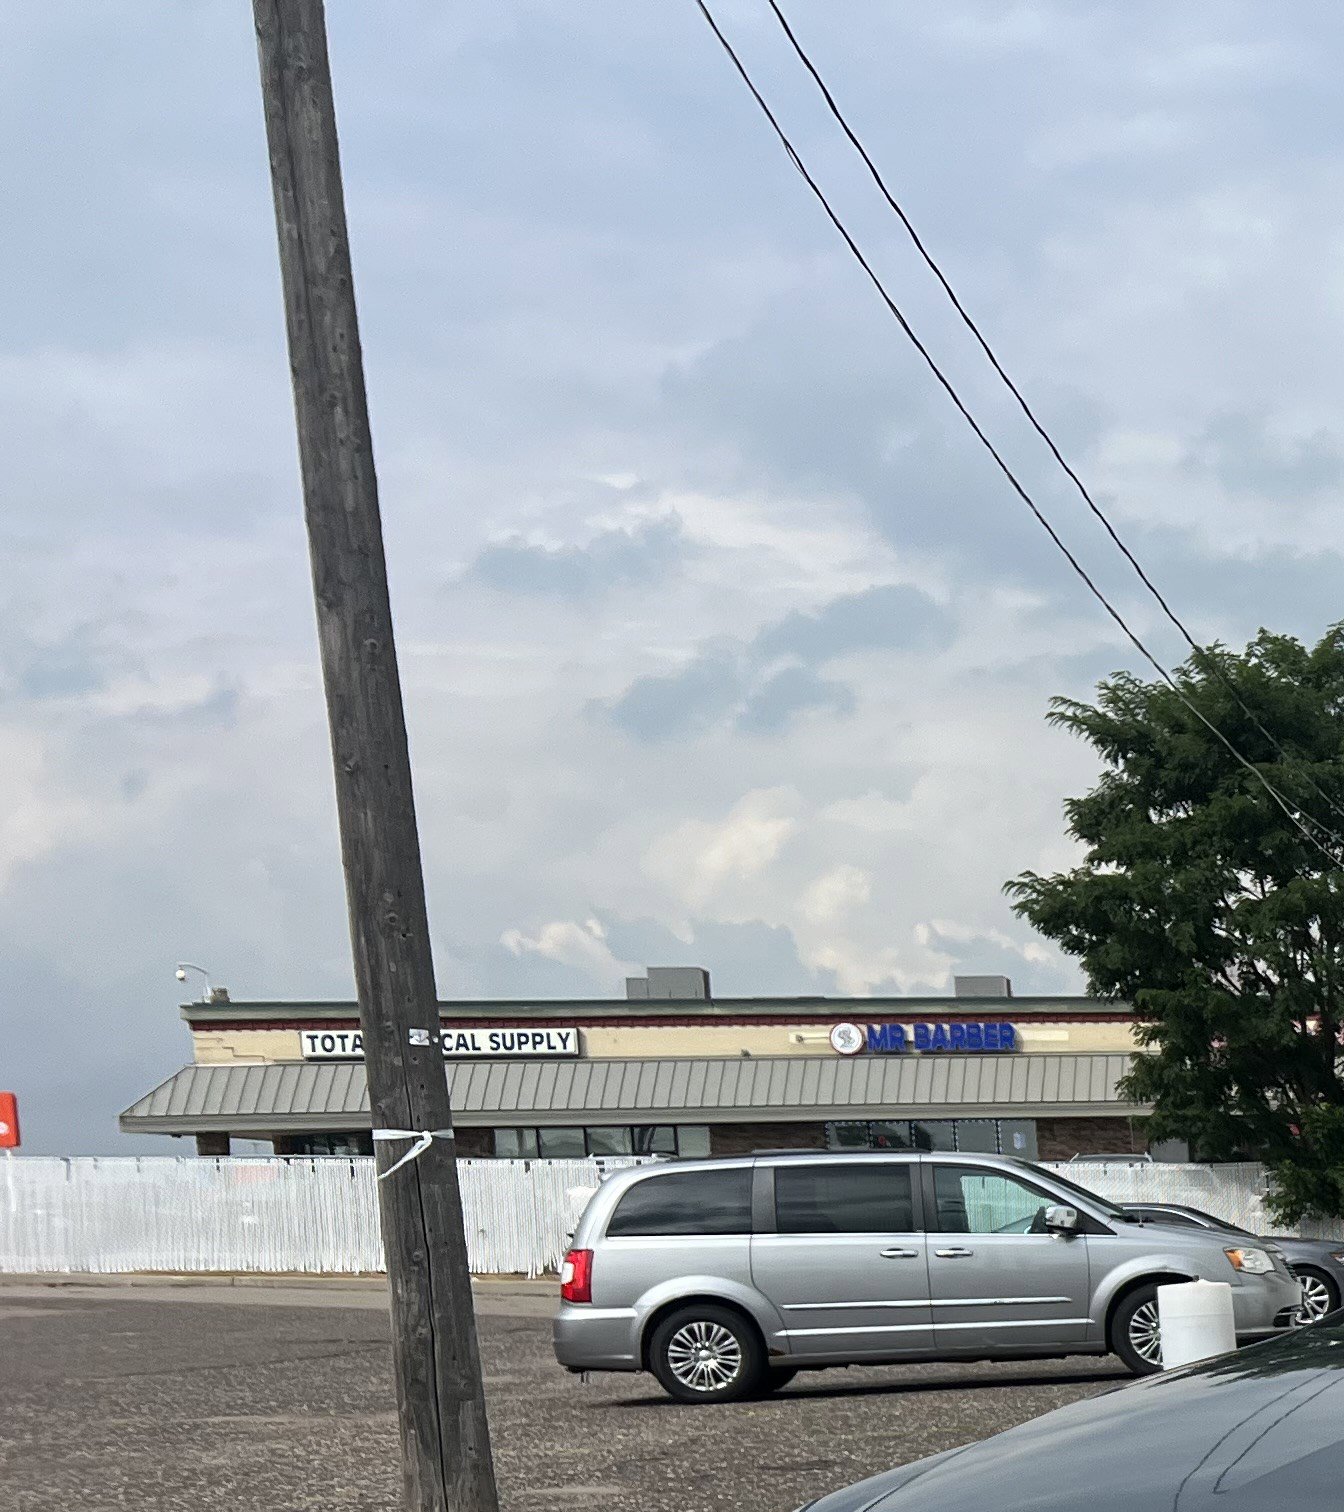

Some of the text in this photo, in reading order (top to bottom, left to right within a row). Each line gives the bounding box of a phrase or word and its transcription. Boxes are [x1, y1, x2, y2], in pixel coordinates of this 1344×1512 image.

[306, 1034, 364, 1053] TOTA
[489, 1031, 571, 1051] SUPPLY
[866, 1022, 1016, 1050] MR BARBER
